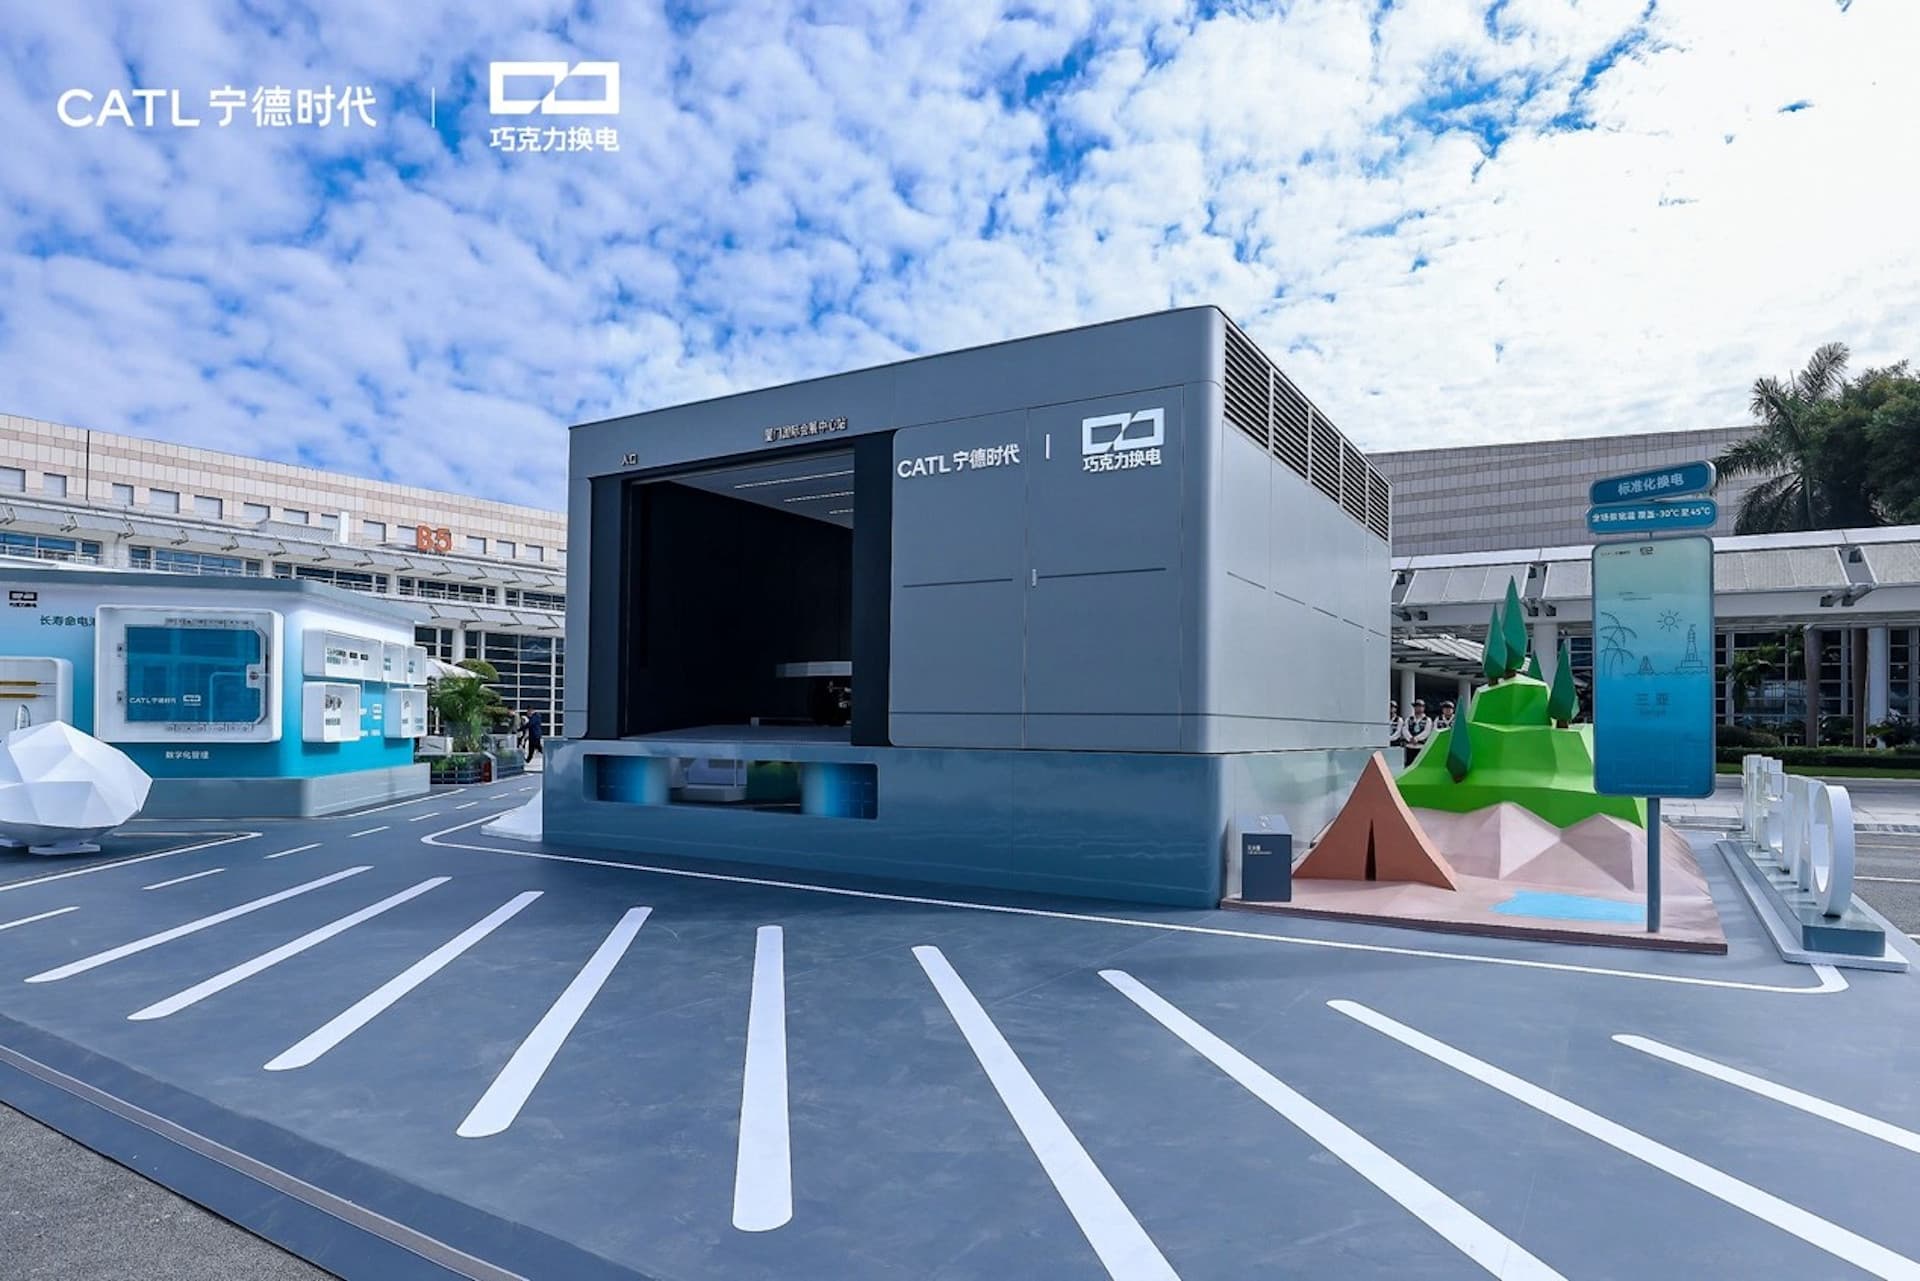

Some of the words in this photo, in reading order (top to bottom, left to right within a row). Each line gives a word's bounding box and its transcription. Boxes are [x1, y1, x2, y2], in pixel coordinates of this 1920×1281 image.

[897, 455, 951, 478] CATL
[953, 443, 1020, 471] 宁德时代
[1082, 448, 1161, 473] 巧克力换电
[1618, 473, 1684, 496] 标准化换电
[416, 525, 451, 552] B5
